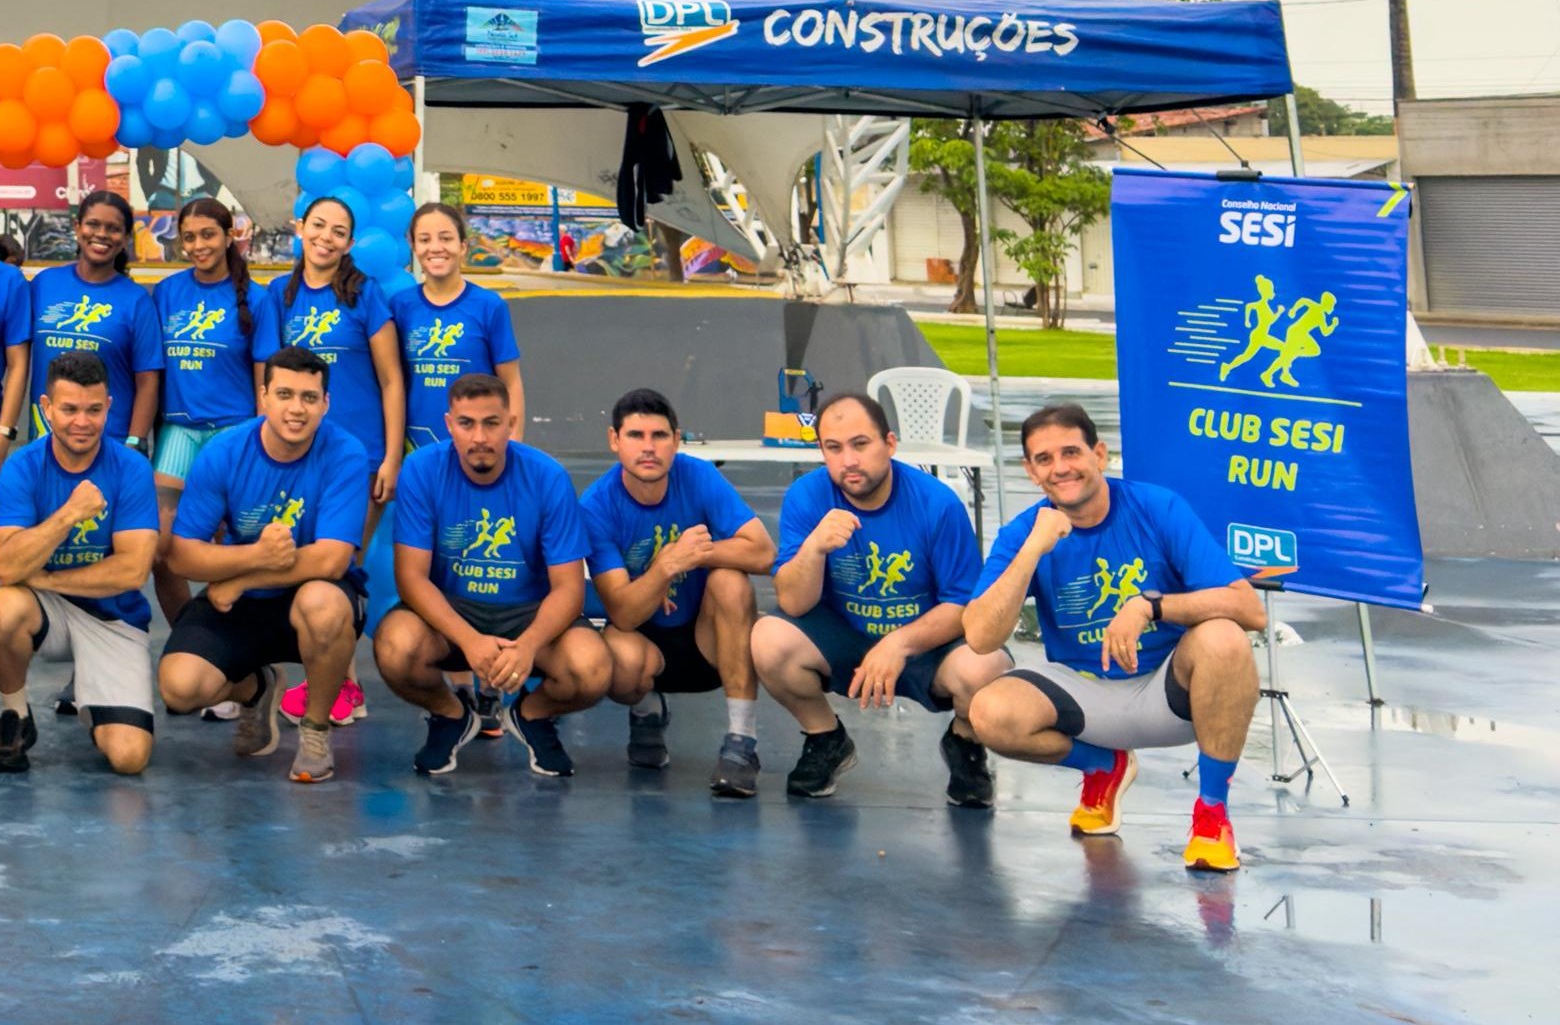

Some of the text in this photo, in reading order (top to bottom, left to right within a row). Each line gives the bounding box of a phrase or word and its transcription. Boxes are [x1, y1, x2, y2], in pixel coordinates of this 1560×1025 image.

[650, 1, 724, 26] DPL
[764, 9, 1080, 62] CONSTRUÇÕES
[499, 192, 517, 201] 555
[1221, 199, 1297, 212] Conselho Nacional
[45, 336, 99, 351] CLUB SESI
[167, 346, 216, 358] CLUB SESI
[180, 359, 203, 370] RUN
[437, 364, 460, 374] SESI
[424, 376, 447, 387] RUN
[1189, 408, 1345, 454] CLUB SESI
[1228, 455, 1298, 491] RUN
[1234, 530, 1292, 562] DPL
[452, 561, 517, 580] CLUB SESI
[467, 580, 499, 594] RUN
[846, 601, 920, 619] CLUB SESI
[1077, 627, 1108, 645] CLU
